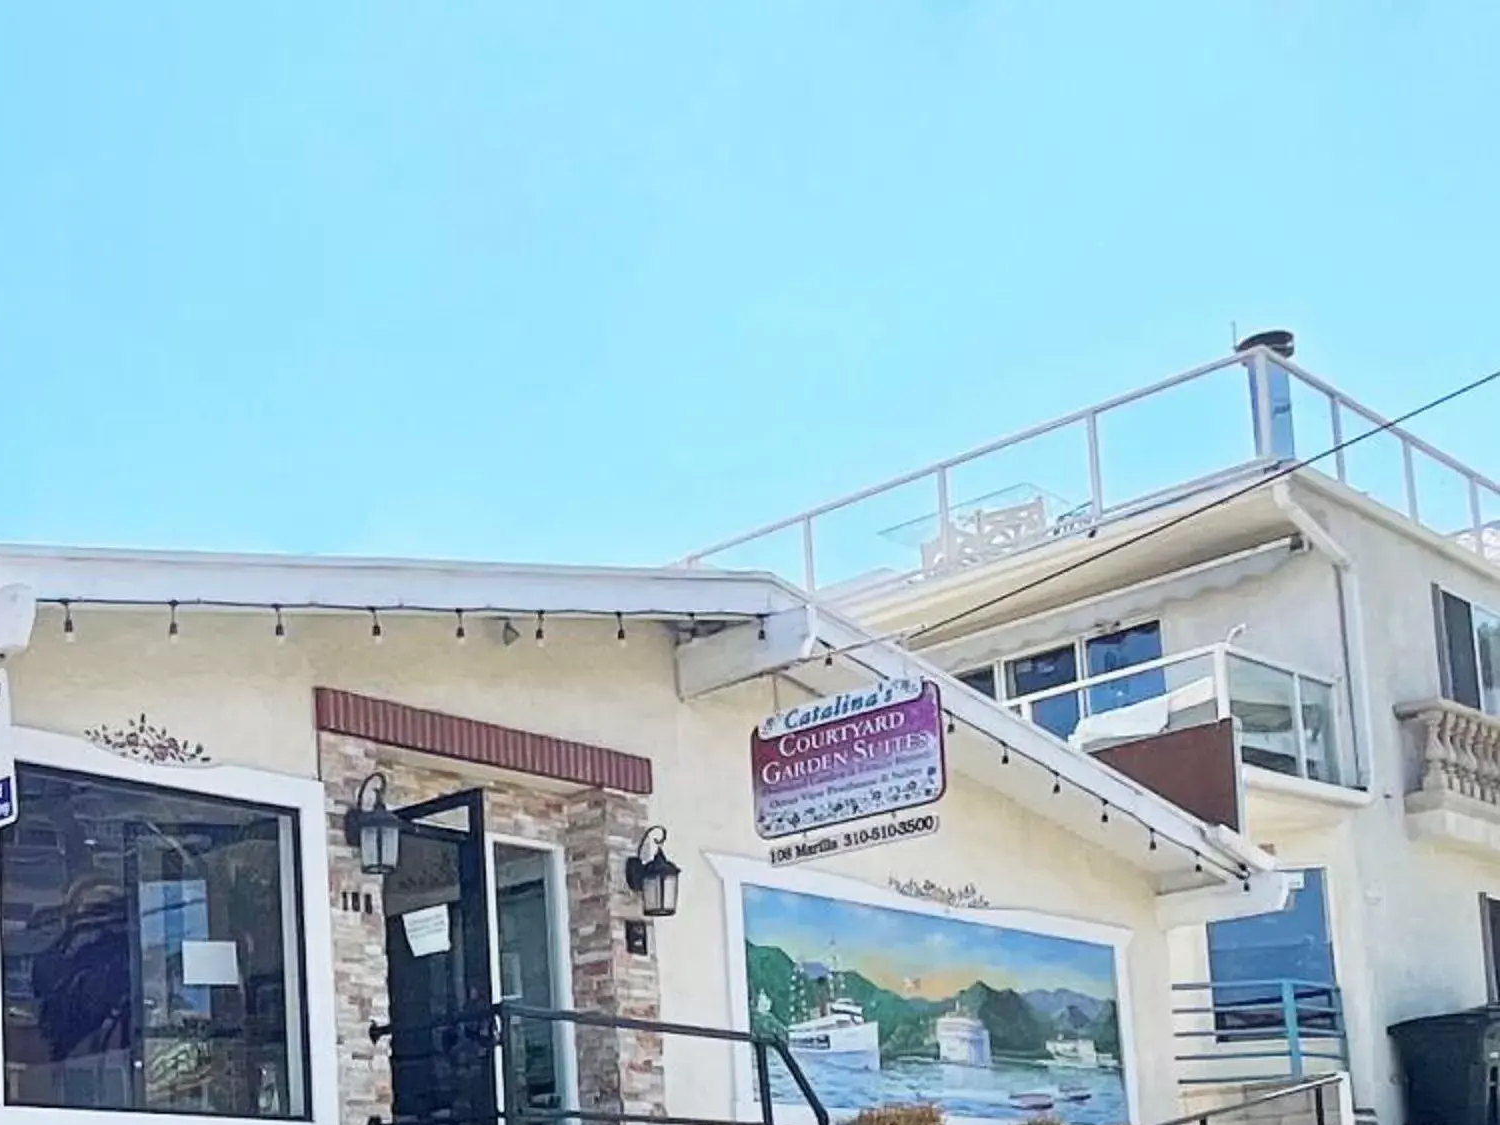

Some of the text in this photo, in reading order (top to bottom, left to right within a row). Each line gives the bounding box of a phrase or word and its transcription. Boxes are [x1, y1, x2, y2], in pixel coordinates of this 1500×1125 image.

[785, 683, 893, 729] Catalina's
[761, 749, 849, 785] GARDEN
[853, 729, 936, 763] SUITES
[778, 711, 905, 757] COURTYARD
